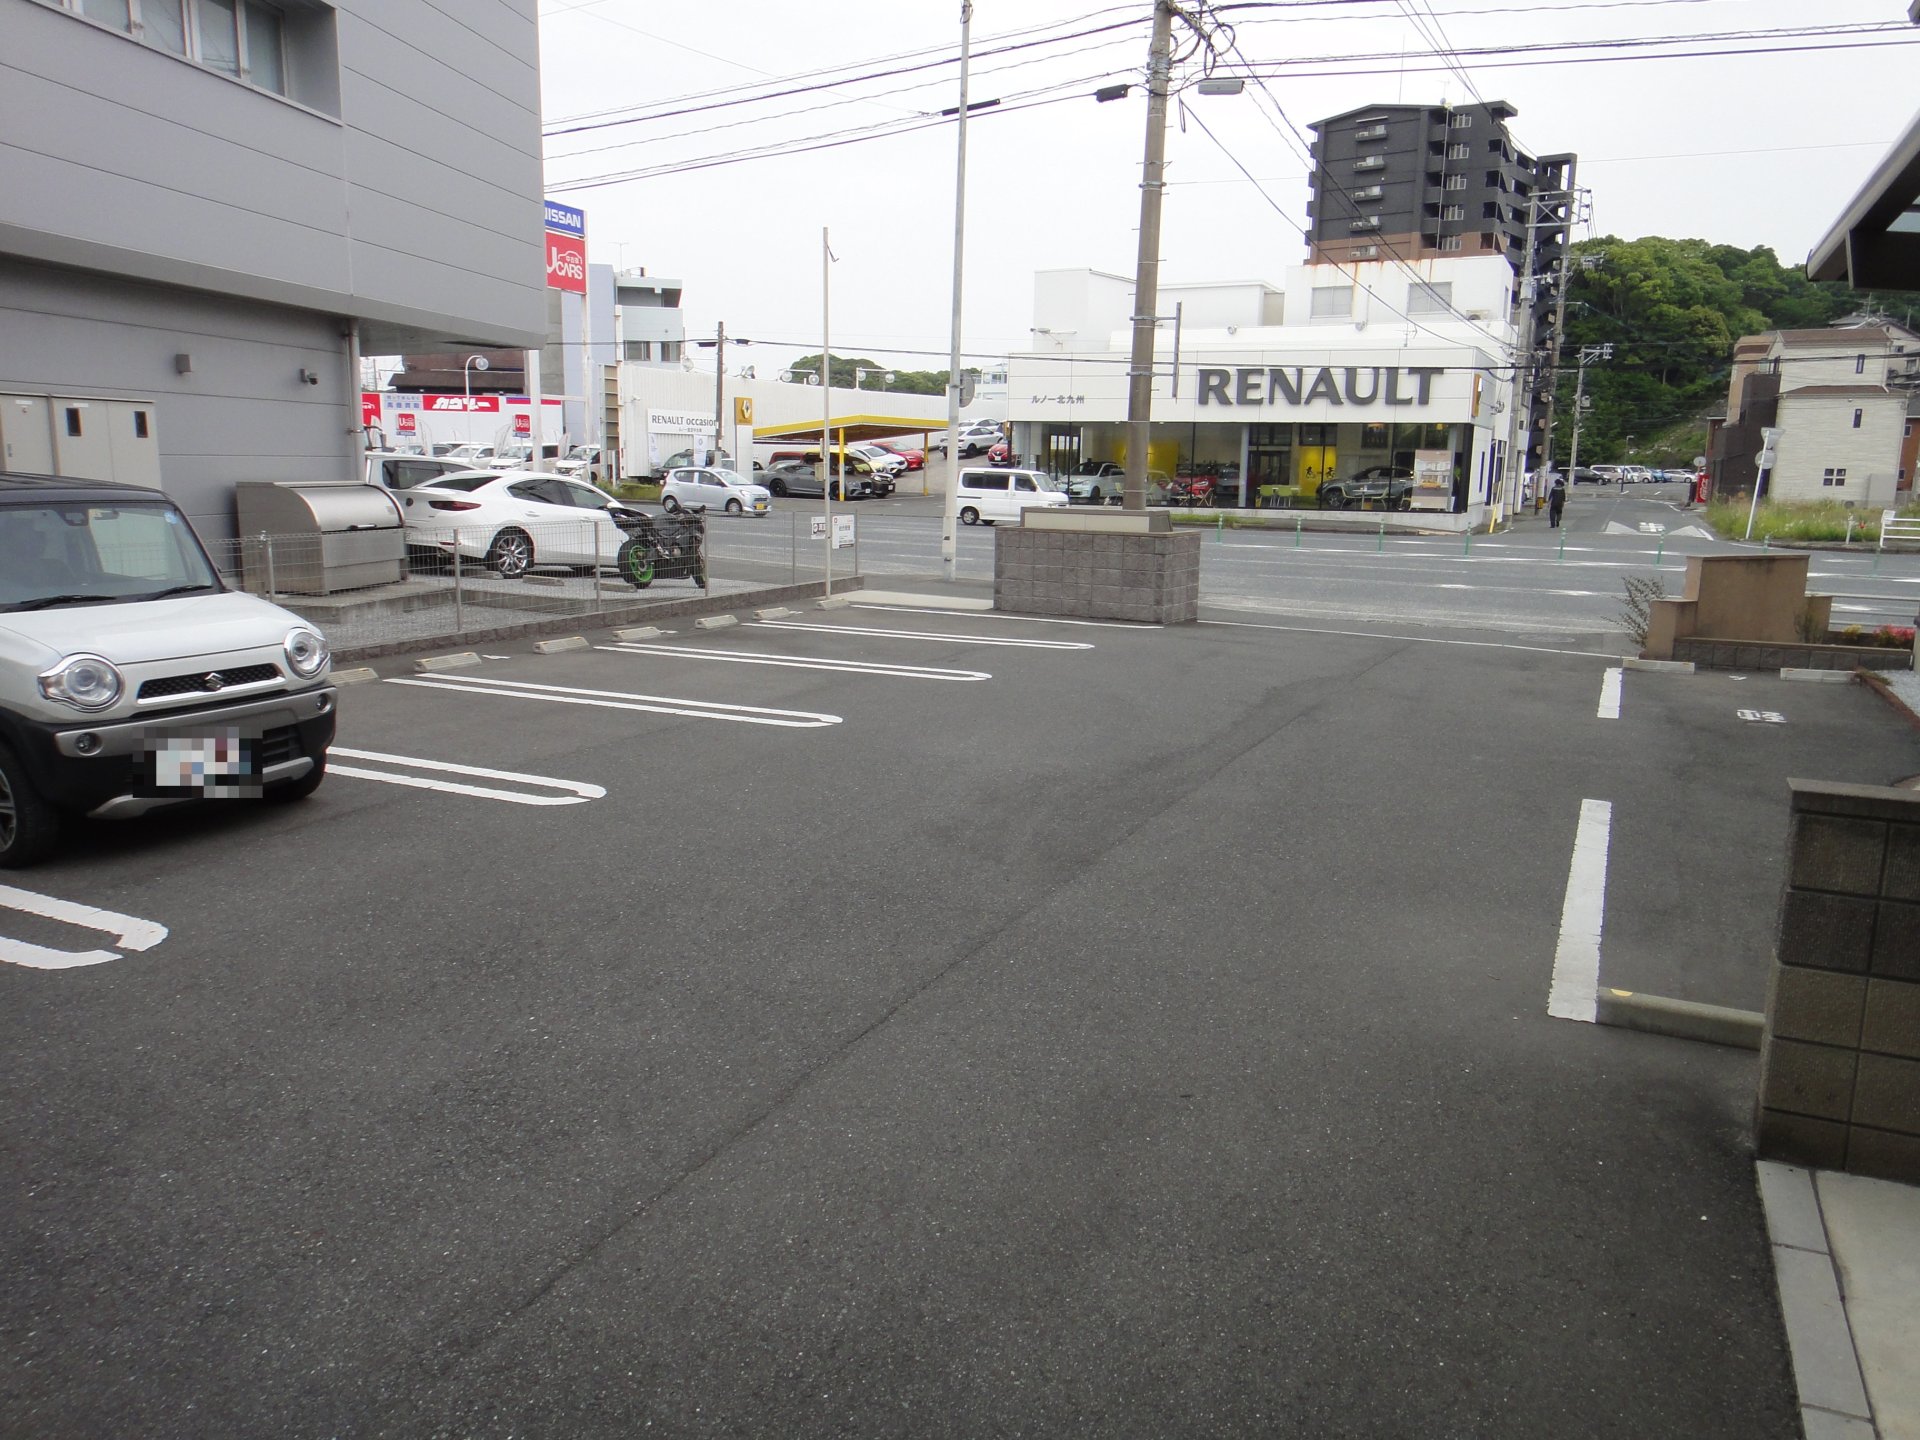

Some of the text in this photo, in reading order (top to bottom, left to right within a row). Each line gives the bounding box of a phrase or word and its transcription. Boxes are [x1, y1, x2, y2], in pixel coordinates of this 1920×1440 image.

[1198, 367, 1444, 406] RENAULT
[1031, 395, 1084, 404] ルノー北九州
[652, 415, 684, 425] RENAULT
